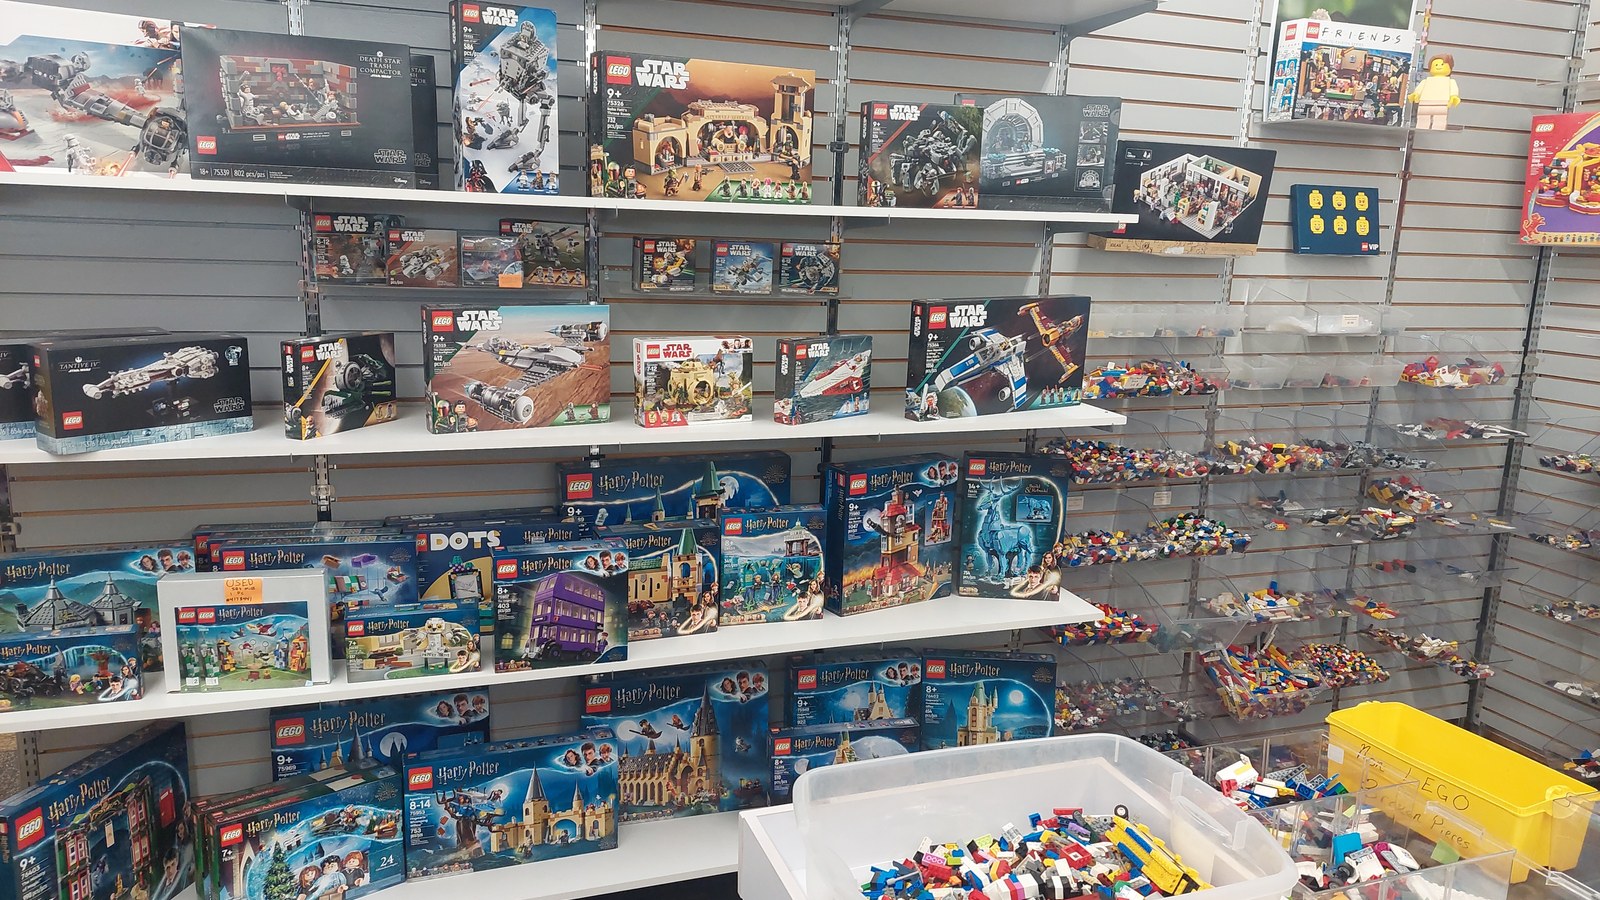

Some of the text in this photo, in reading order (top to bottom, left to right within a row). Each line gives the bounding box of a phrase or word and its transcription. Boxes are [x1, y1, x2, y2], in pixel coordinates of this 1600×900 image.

[464, 9, 479, 18] LEGO
[482, 7, 518, 19] STAR
[482, 16, 518, 27] WARS
[608, 64, 630, 76] LEGO
[636, 60, 690, 76] STAR
[636, 72, 690, 90] WARS
[606, 88, 622, 98] 9+
[890, 104, 920, 114] STAR
[1083, 103, 1110, 112] STAR
[890, 112, 920, 121] WARS
[1083, 109, 1110, 118] WARS
[1536, 124, 1553, 132] LEGO
[200, 141, 214, 149] LEGO
[374, 148, 406, 158] STAR
[374, 156, 407, 164] WARS
[334, 216, 368, 226] STAR
[334, 223, 368, 232] WARS
[456, 310, 502, 321] STAR
[949, 304, 988, 317] STAR
[434, 317, 452, 326] LEGO
[930, 312, 946, 323] LEGO
[949, 315, 988, 328] WARS
[456, 319, 503, 332] WARS
[928, 333, 938, 342] 9+
[316, 342, 342, 352] STAR
[808, 342, 830, 352] STAR
[316, 350, 342, 360] WARS
[662, 350, 692, 358] WARS
[808, 349, 830, 358] WARS
[60, 362, 89, 370] TANTIVE
[214, 397, 244, 407] STAR
[214, 404, 244, 414] WARS
[64, 416, 82, 426] LEGO
[988, 461, 1009, 474] Harry
[1009, 460, 1032, 473] Potter
[568, 470, 664, 495] LEGO Harry Potter
[851, 470, 914, 491] LEGO Harry Potter
[567, 506, 582, 516] 9+
[848, 502, 858, 512] 9+
[726, 516, 789, 532] LEGO Harry Potter
[548, 528, 573, 540] Potter
[430, 530, 500, 552] DOTS
[648, 534, 672, 549] Potter
[224, 549, 306, 567] LEGO Harry Potter
[498, 556, 573, 575] LEGO Harry Potter
[5, 561, 71, 582] Harry Potter
[226, 578, 254, 588] USED
[178, 605, 264, 620] LEGO LEGO Harry Potter
[348, 618, 410, 634] LEGO Harry Potter
[26, 642, 52, 657] Potter
[799, 666, 870, 684] LEGO Harry Potter
[928, 662, 1000, 677] LEGO Harry Potter
[588, 682, 680, 706] LEGO Harry Potter
[276, 710, 386, 738] LEGO Harry Potter
[794, 738, 815, 752] Harry
[815, 736, 836, 748] Potter
[277, 755, 293, 765] 9+
[410, 760, 500, 785] LEGO Harry Potter
[18, 776, 110, 840] LEGO Harry Potter
[410, 800, 431, 810] 8-14
[222, 812, 300, 842] LEGO Harry Potter
[1430, 814, 1470, 850] Pieces
[222, 849, 232, 857] 7+
[20, 856, 36, 871] 9+
[380, 854, 394, 867] 24
